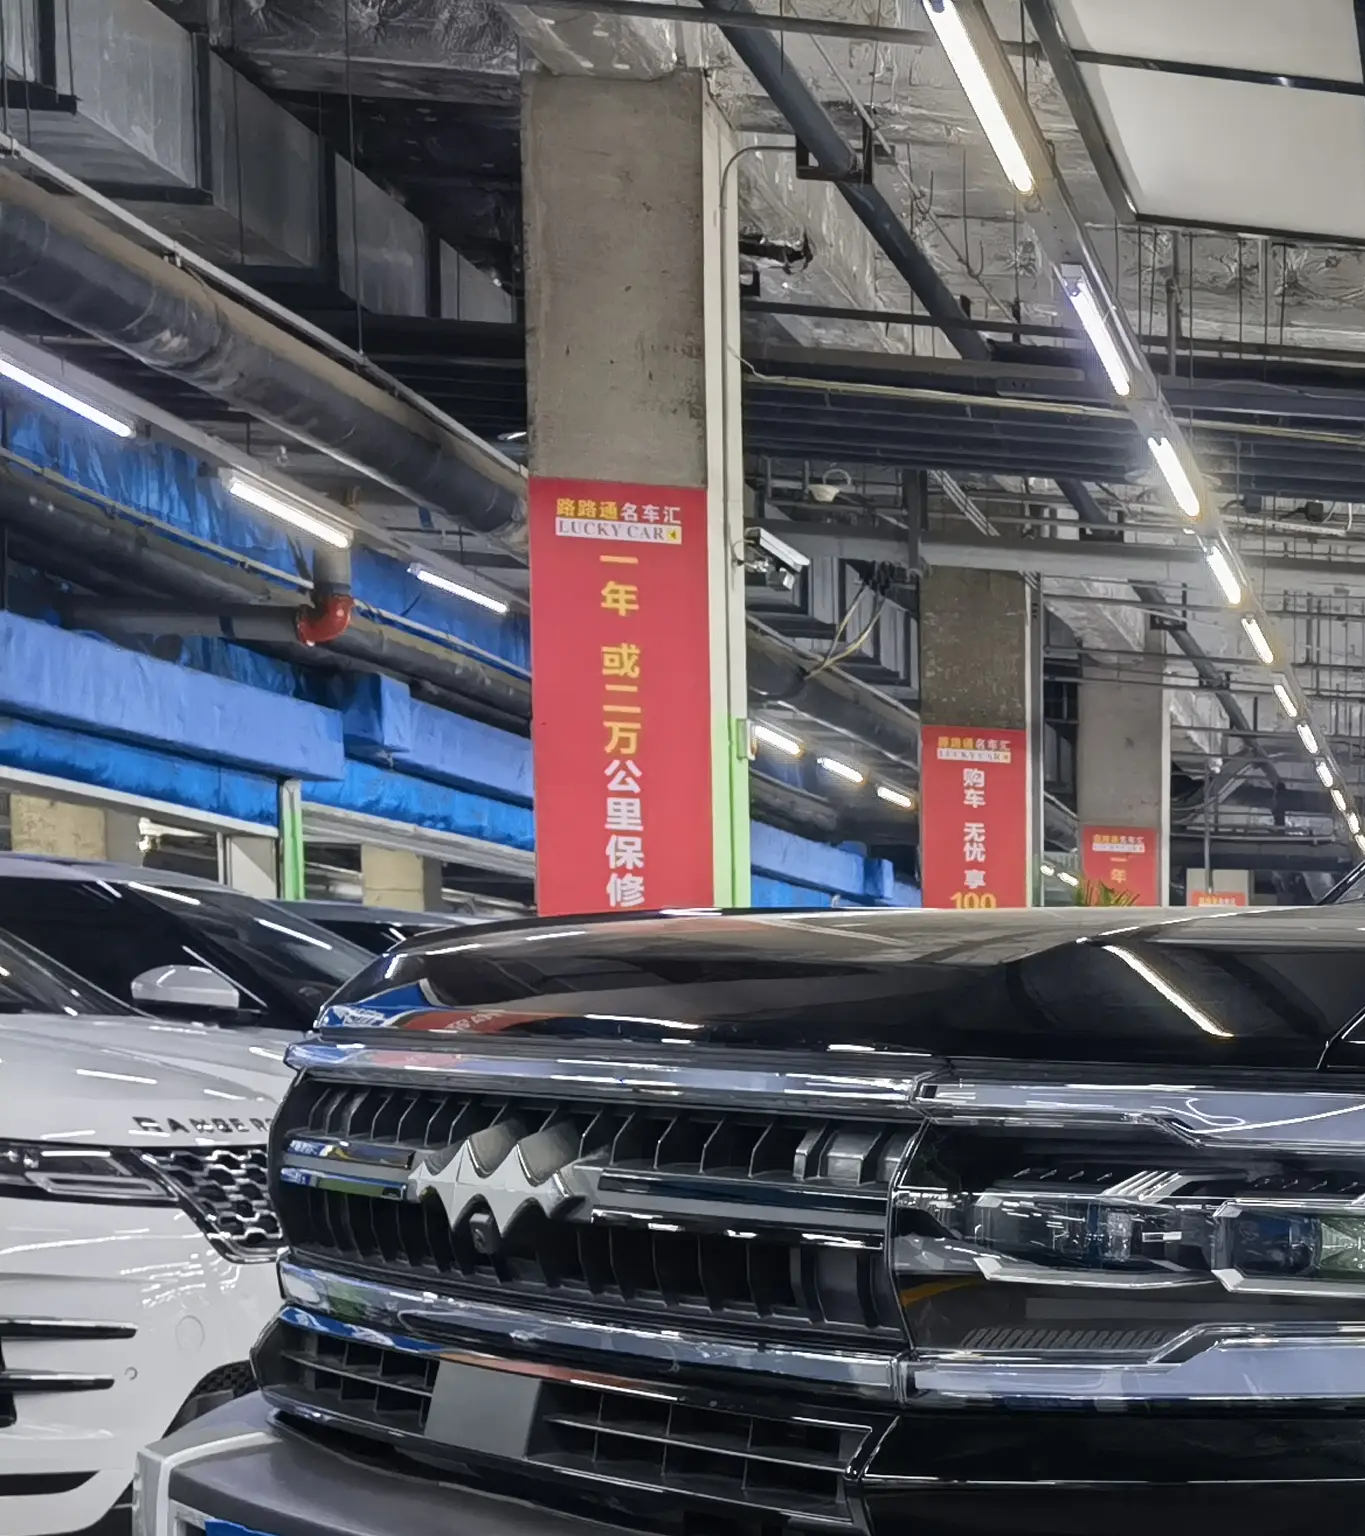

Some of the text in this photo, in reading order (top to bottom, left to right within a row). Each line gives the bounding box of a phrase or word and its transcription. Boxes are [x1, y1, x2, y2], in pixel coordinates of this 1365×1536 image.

[556, 497, 681, 525] 路路通名车汇
[559, 519, 665, 541] LUCKY CAR
